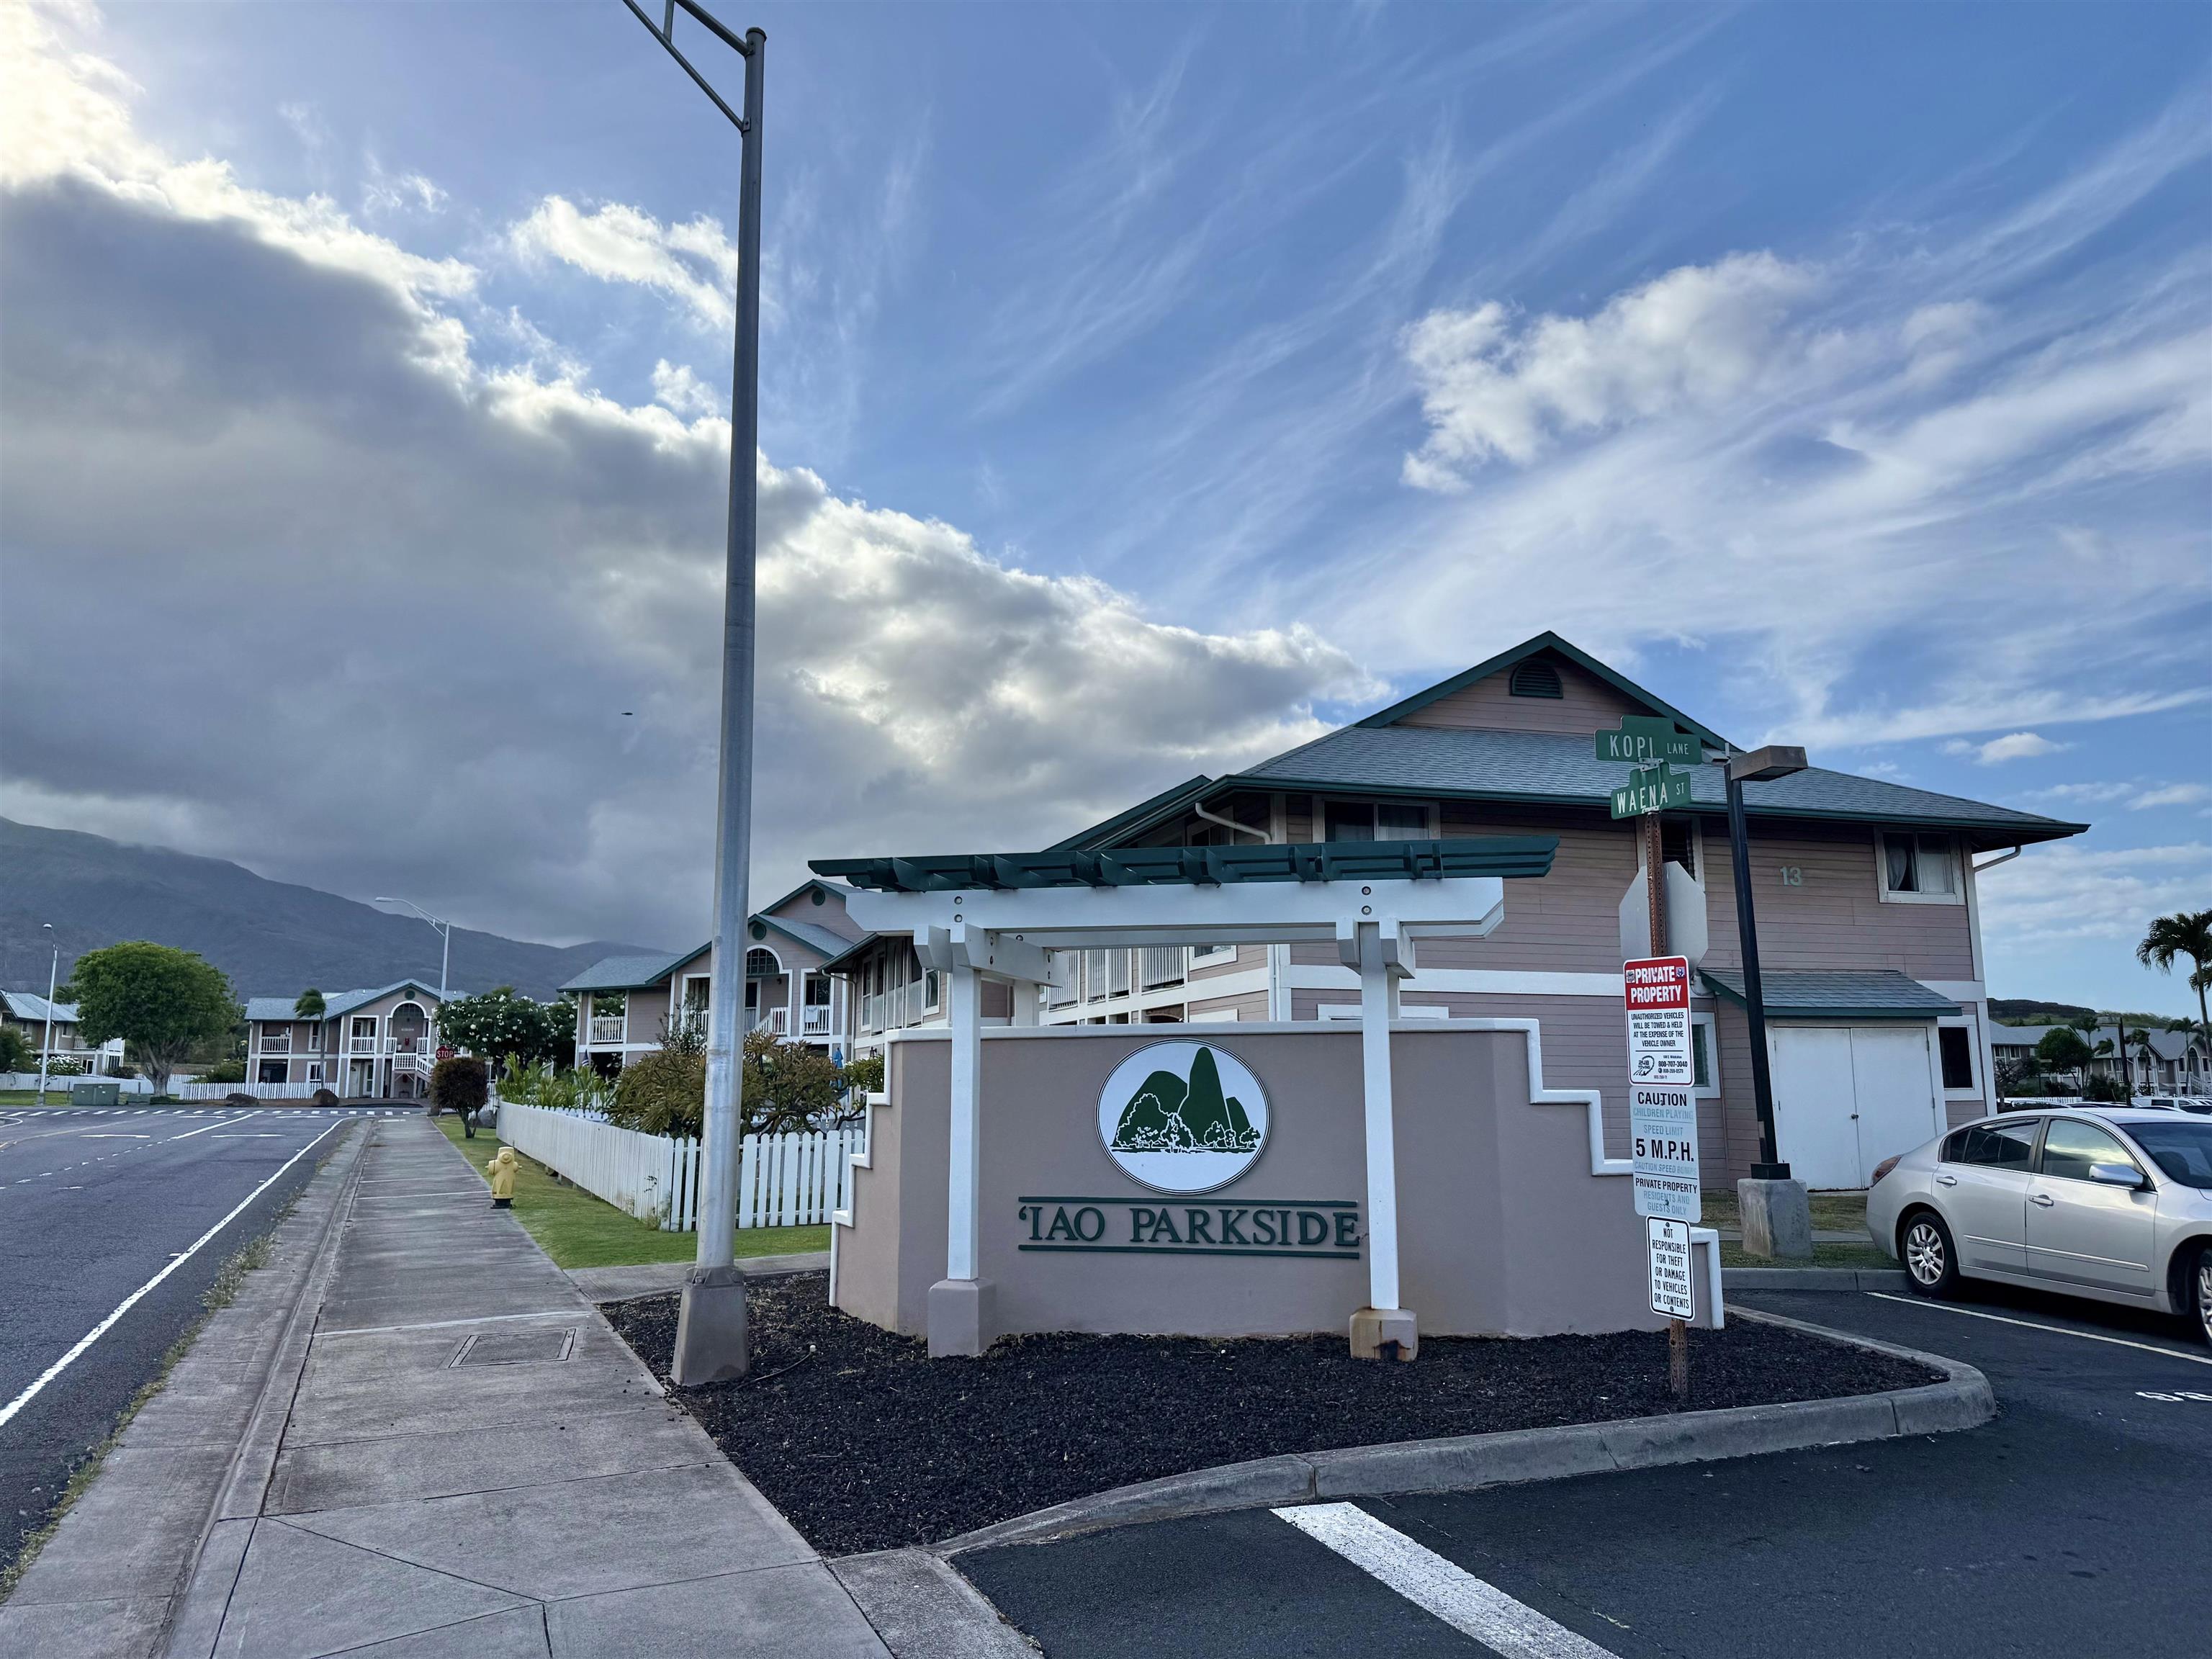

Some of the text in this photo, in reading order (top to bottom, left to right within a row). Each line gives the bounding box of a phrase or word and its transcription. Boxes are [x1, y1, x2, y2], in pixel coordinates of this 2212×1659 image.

[1609, 734, 1689, 758] KOPI LANE
[1617, 782, 1685, 814] WAENA ST
[1779, 866, 1803, 887] 13
[1635, 966, 1676, 984] PRIVATE
[1630, 985, 1682, 1003] PROPERTY
[1637, 1092, 1687, 1107] CAUTION
[1633, 1107, 1694, 1120] CHILDREN PLAYING
[1643, 1124, 1683, 1136] SPEED LIMIT
[1635, 1138, 1694, 1162] 5 M.P.H.
[1635, 1161, 1658, 1172] CAUTION
[1658, 1164, 1676, 1174] SPEED
[1635, 1177, 1698, 1194] PRIVATE PROPERTY
[1643, 1190, 1690, 1205] RESIDENTS AND
[1647, 1201, 1686, 1216] GUESTS ONLY
[1129, 1208, 1360, 1247] PARKSIDE
[1663, 1228, 1673, 1238] NOT
[1652, 1239, 1686, 1254] RESPONSIBLE
[1656, 1253, 1683, 1267] FOR THEFT
[1655, 1266, 1686, 1281] OR DAMAGE
[1655, 1279, 1688, 1295] TO VEHICLES
[1654, 1292, 1689, 1309] OR CONTENTS
